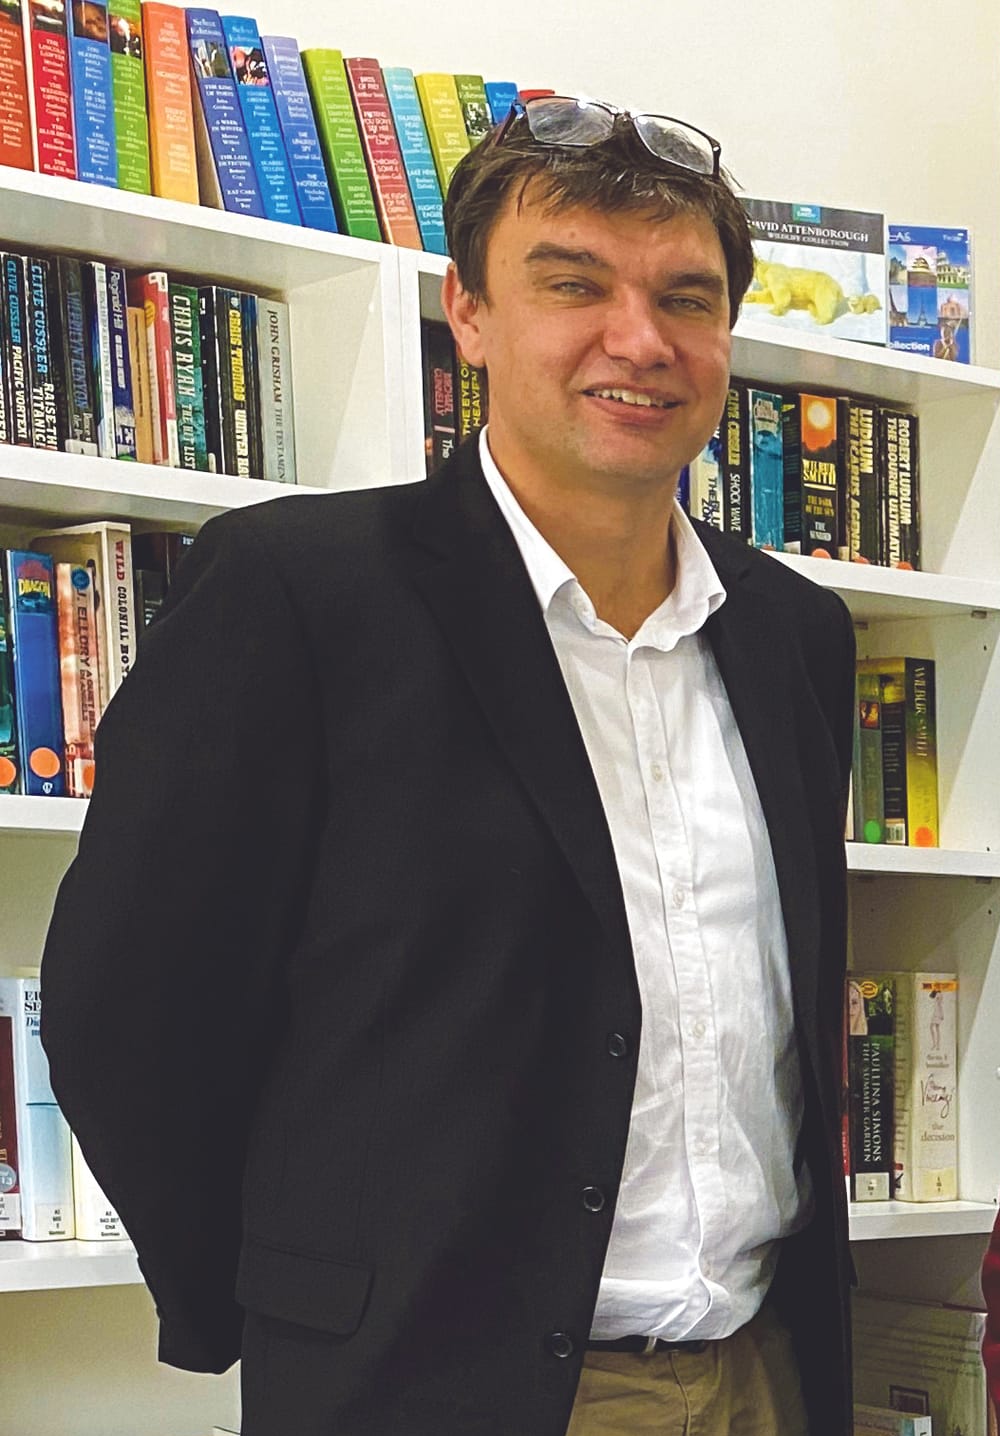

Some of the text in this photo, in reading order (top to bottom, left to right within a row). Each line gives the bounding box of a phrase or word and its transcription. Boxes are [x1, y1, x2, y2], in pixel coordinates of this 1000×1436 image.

[780, 223, 869, 243] ATTENBOROUGH
[802, 235, 849, 248] COLLECTION
[7, 260, 24, 389] CLIVE CUSSLER PACIFIC
[31, 265, 48, 374] CLIVE CUSSLER
[71, 358, 89, 409] KENYON
[173, 295, 196, 470] CHRIS RYAN LIST
[266, 309, 283, 405] JOHN GRISHAM
[461, 381, 472, 437] THE EYE
[850, 407, 859, 438] THE
[859, 408, 874, 474] LUDLUM
[887, 417, 899, 497] THE BOURNE
[898, 418, 912, 525] ROBERT LUDLUM
[730, 472, 742, 533] SHOCK WAVE
[17, 577, 51, 599] DRAGON
[115, 539, 129, 643] WILD COLONIAL
[77, 606, 90, 667] ELLORY
[913, 666, 927, 715] WILBUR
[862, 1067, 871, 1114] SUMMER
[871, 1042, 882, 1162] PAULLINA SIMONS
[862, 1114, 871, 1163] GARDEN
[920, 1129, 956, 1143] decision
